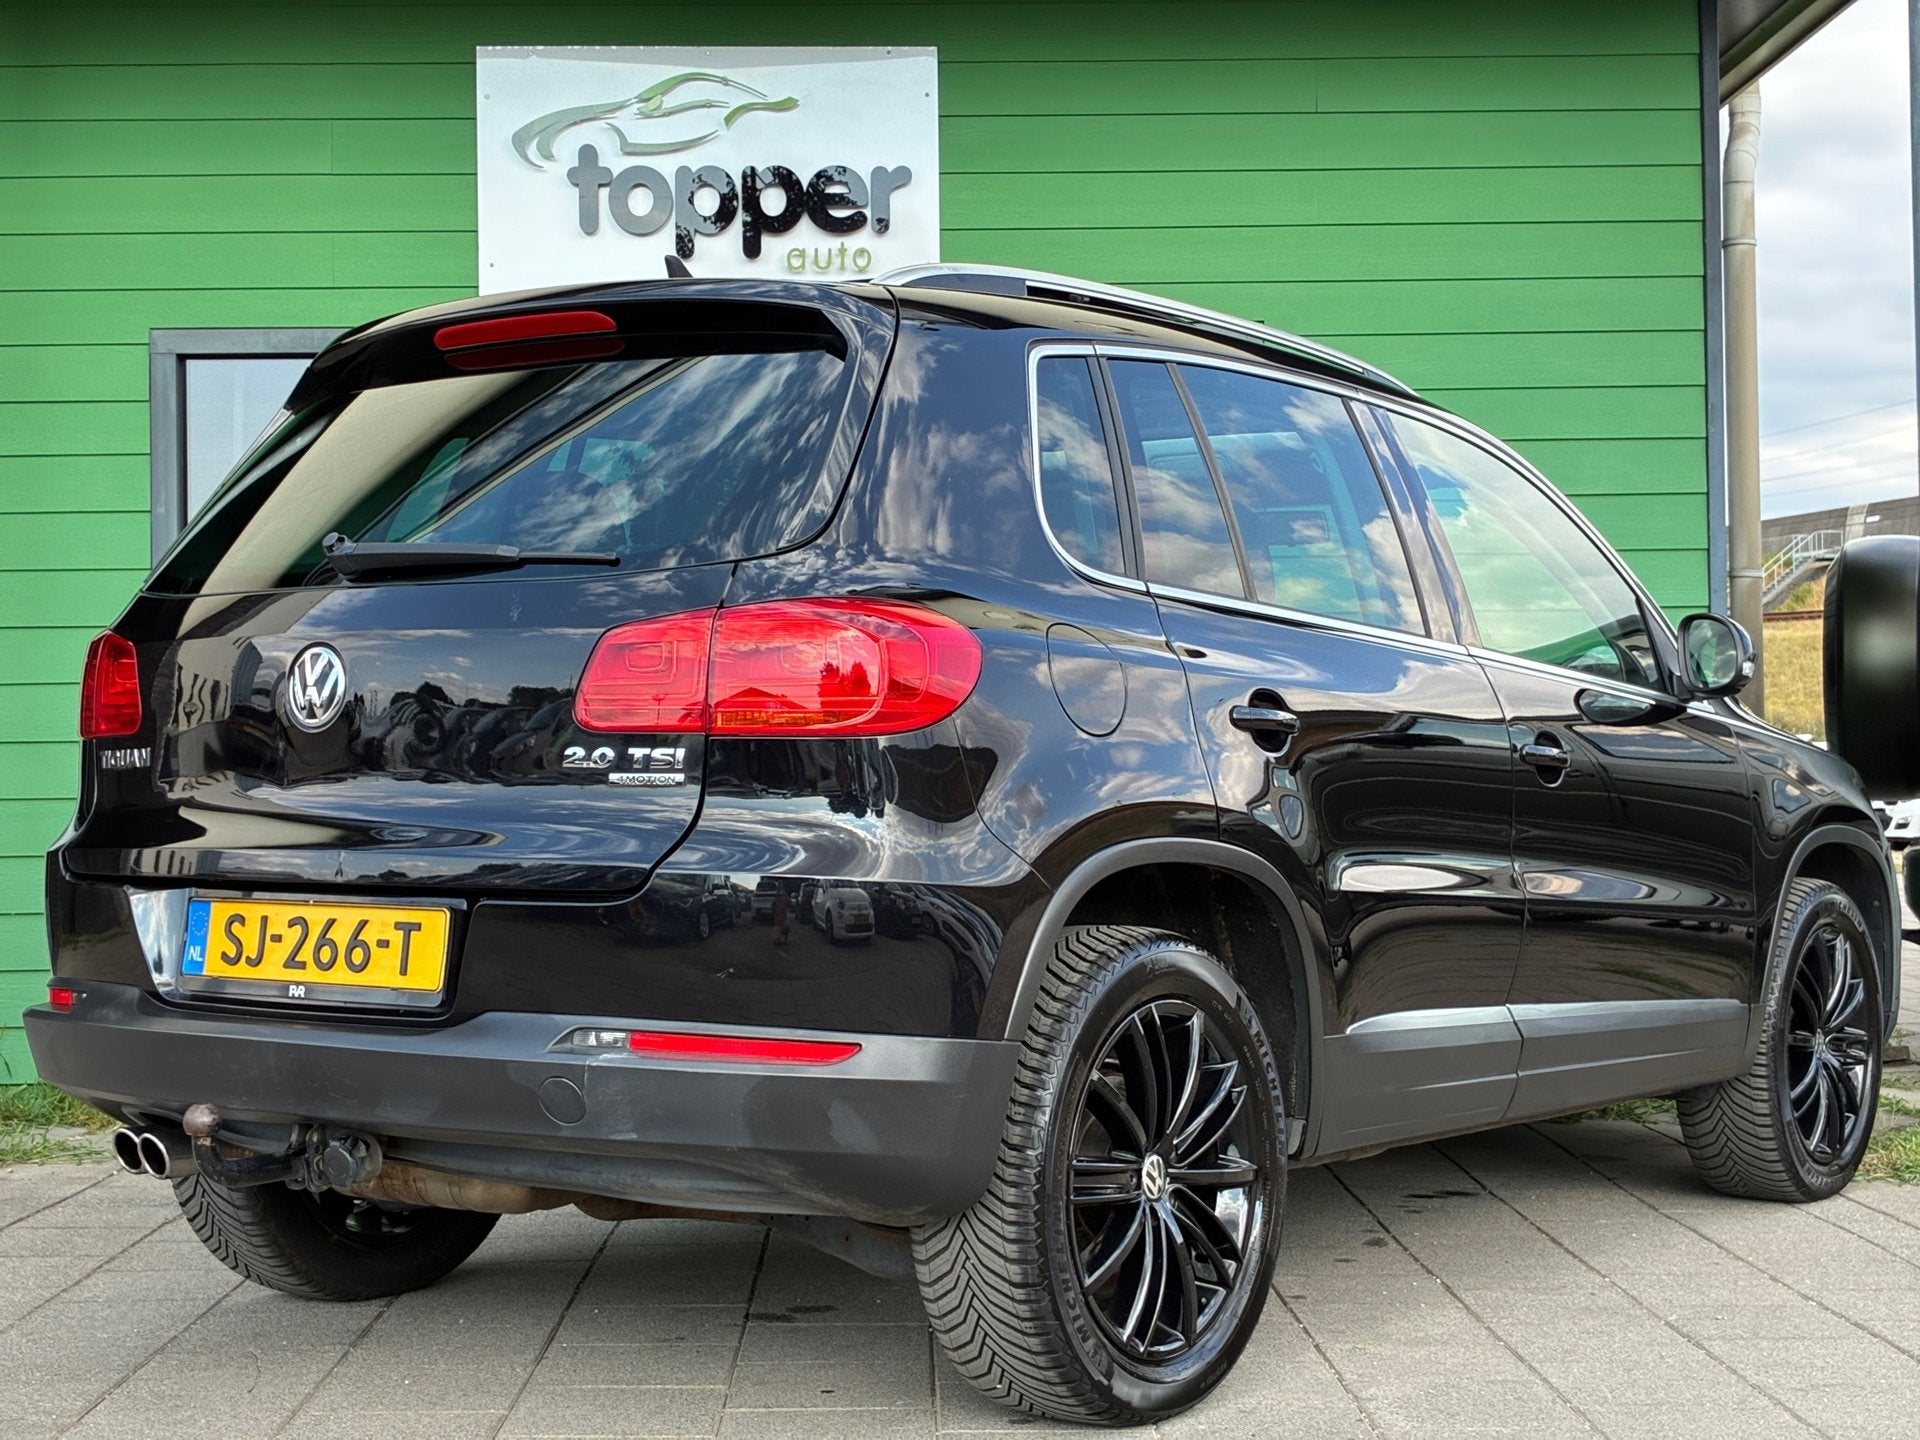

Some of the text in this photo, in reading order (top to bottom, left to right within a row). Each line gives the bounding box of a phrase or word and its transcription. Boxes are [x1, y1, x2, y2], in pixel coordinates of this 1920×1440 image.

[567, 144, 912, 259] topper
[786, 241, 872, 272] auto
[100, 747, 151, 769] TIGUAN
[562, 746, 686, 769] 2.0 TSI
[615, 775, 677, 786] 4MOTION
[188, 913, 422, 976] NL SJ-266-T
[1253, 1030, 1287, 1156] MICHELIN
